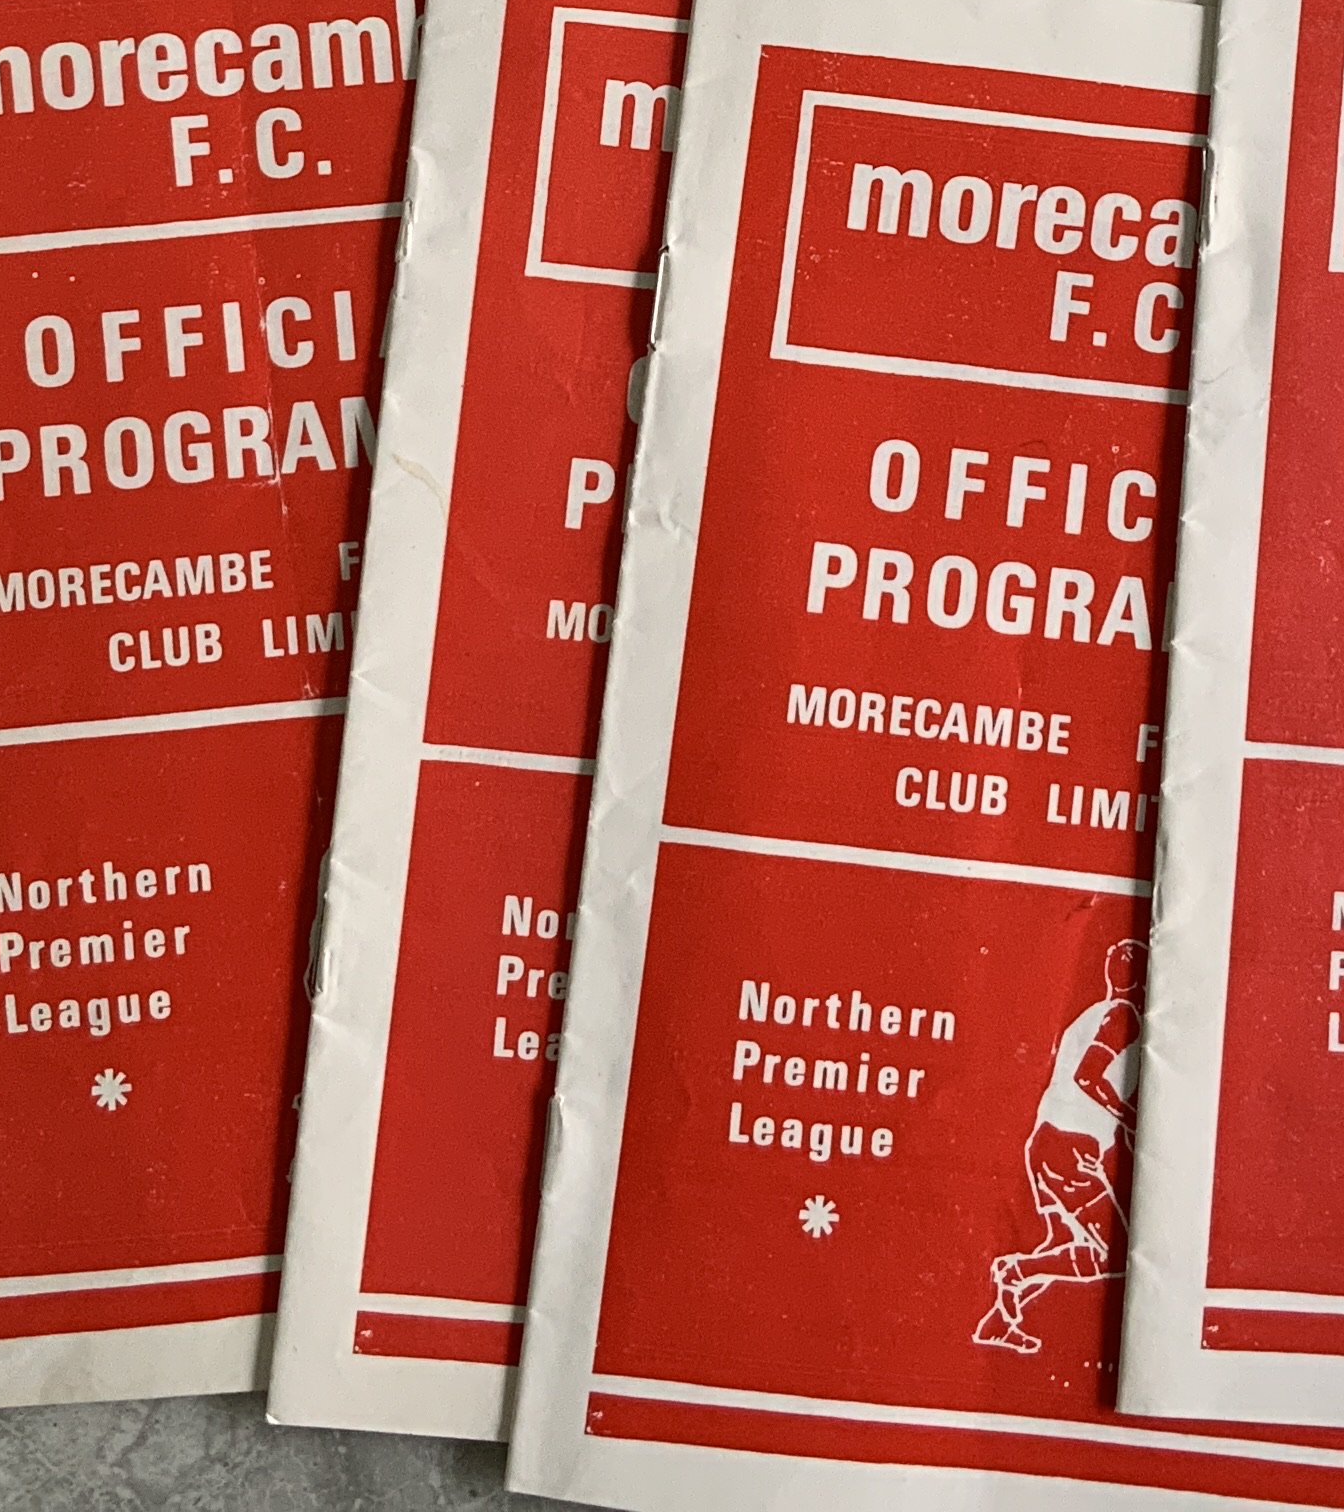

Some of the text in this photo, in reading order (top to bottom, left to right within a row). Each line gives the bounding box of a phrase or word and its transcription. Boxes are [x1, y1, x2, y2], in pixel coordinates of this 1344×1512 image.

[787, 684, 1071, 754] MORECAMBE
[896, 767, 1008, 815] CLUB
[5, 991, 170, 1036] League
